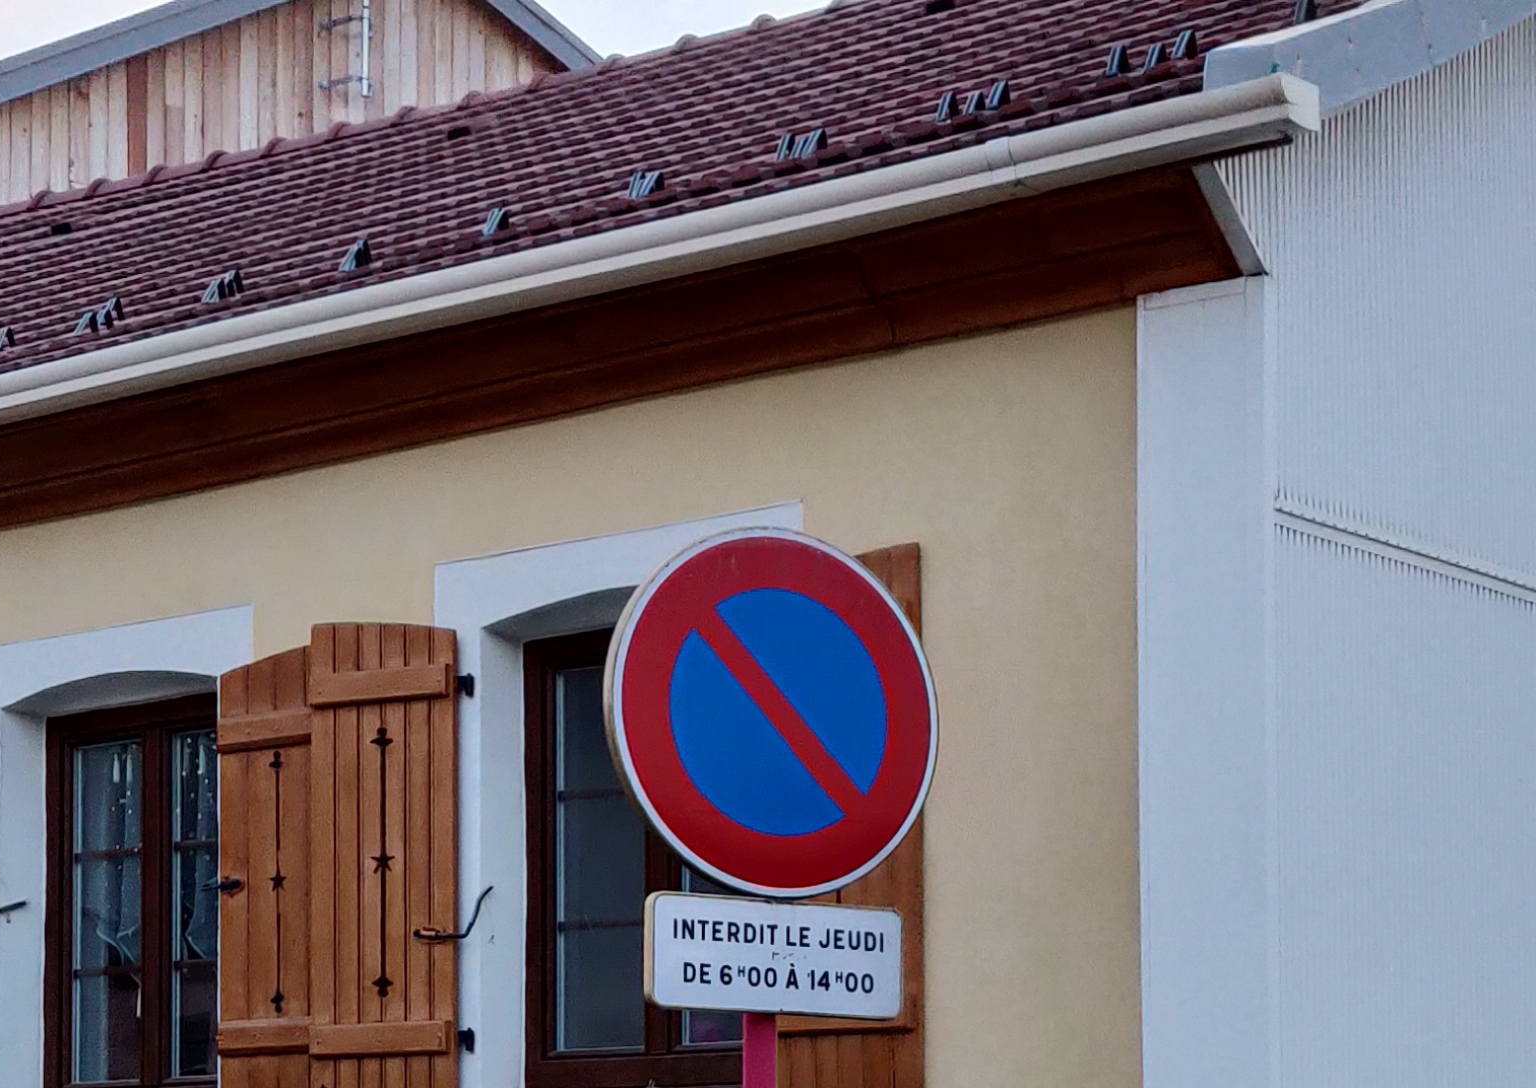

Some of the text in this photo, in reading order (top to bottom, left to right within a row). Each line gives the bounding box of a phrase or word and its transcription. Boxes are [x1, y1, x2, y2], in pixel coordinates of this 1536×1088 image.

[673, 918, 884, 953] INTERDIT LE JEUDI
[683, 962, 712, 985] DE
[786, 963, 799, 990] À
